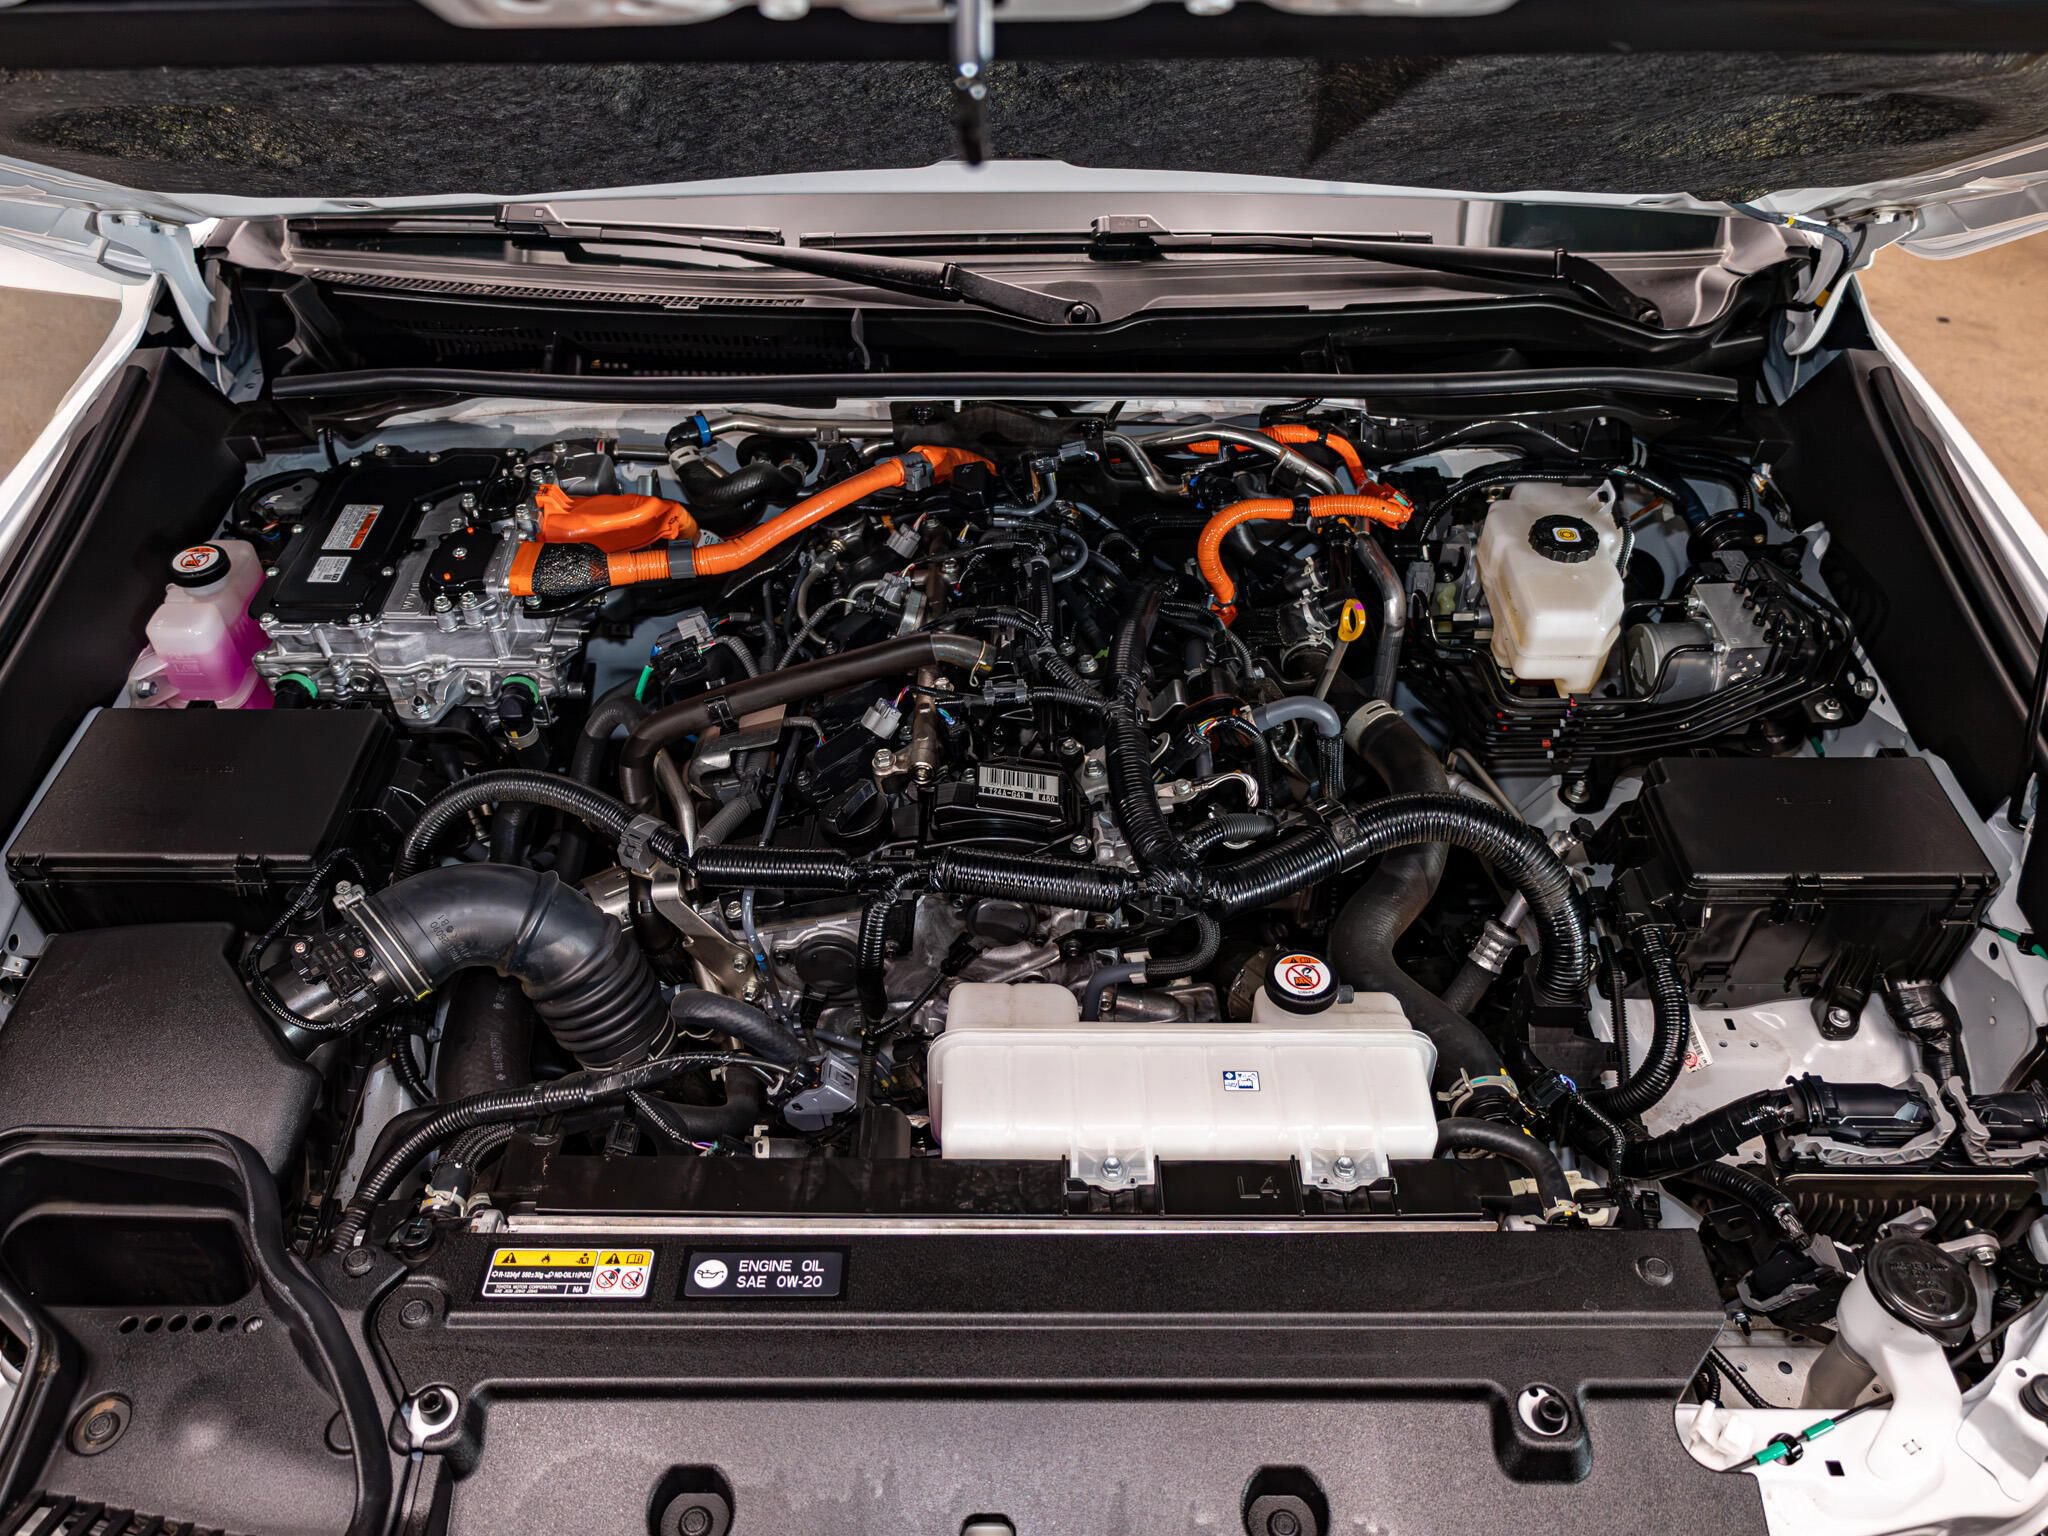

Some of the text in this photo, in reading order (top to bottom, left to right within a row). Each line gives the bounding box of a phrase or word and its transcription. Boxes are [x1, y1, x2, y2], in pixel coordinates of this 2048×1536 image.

[739, 1259, 825, 1273] ENGINE OIL
[736, 1275, 823, 1288] SAE 0W-20
[572, 1285, 584, 1293] NA
